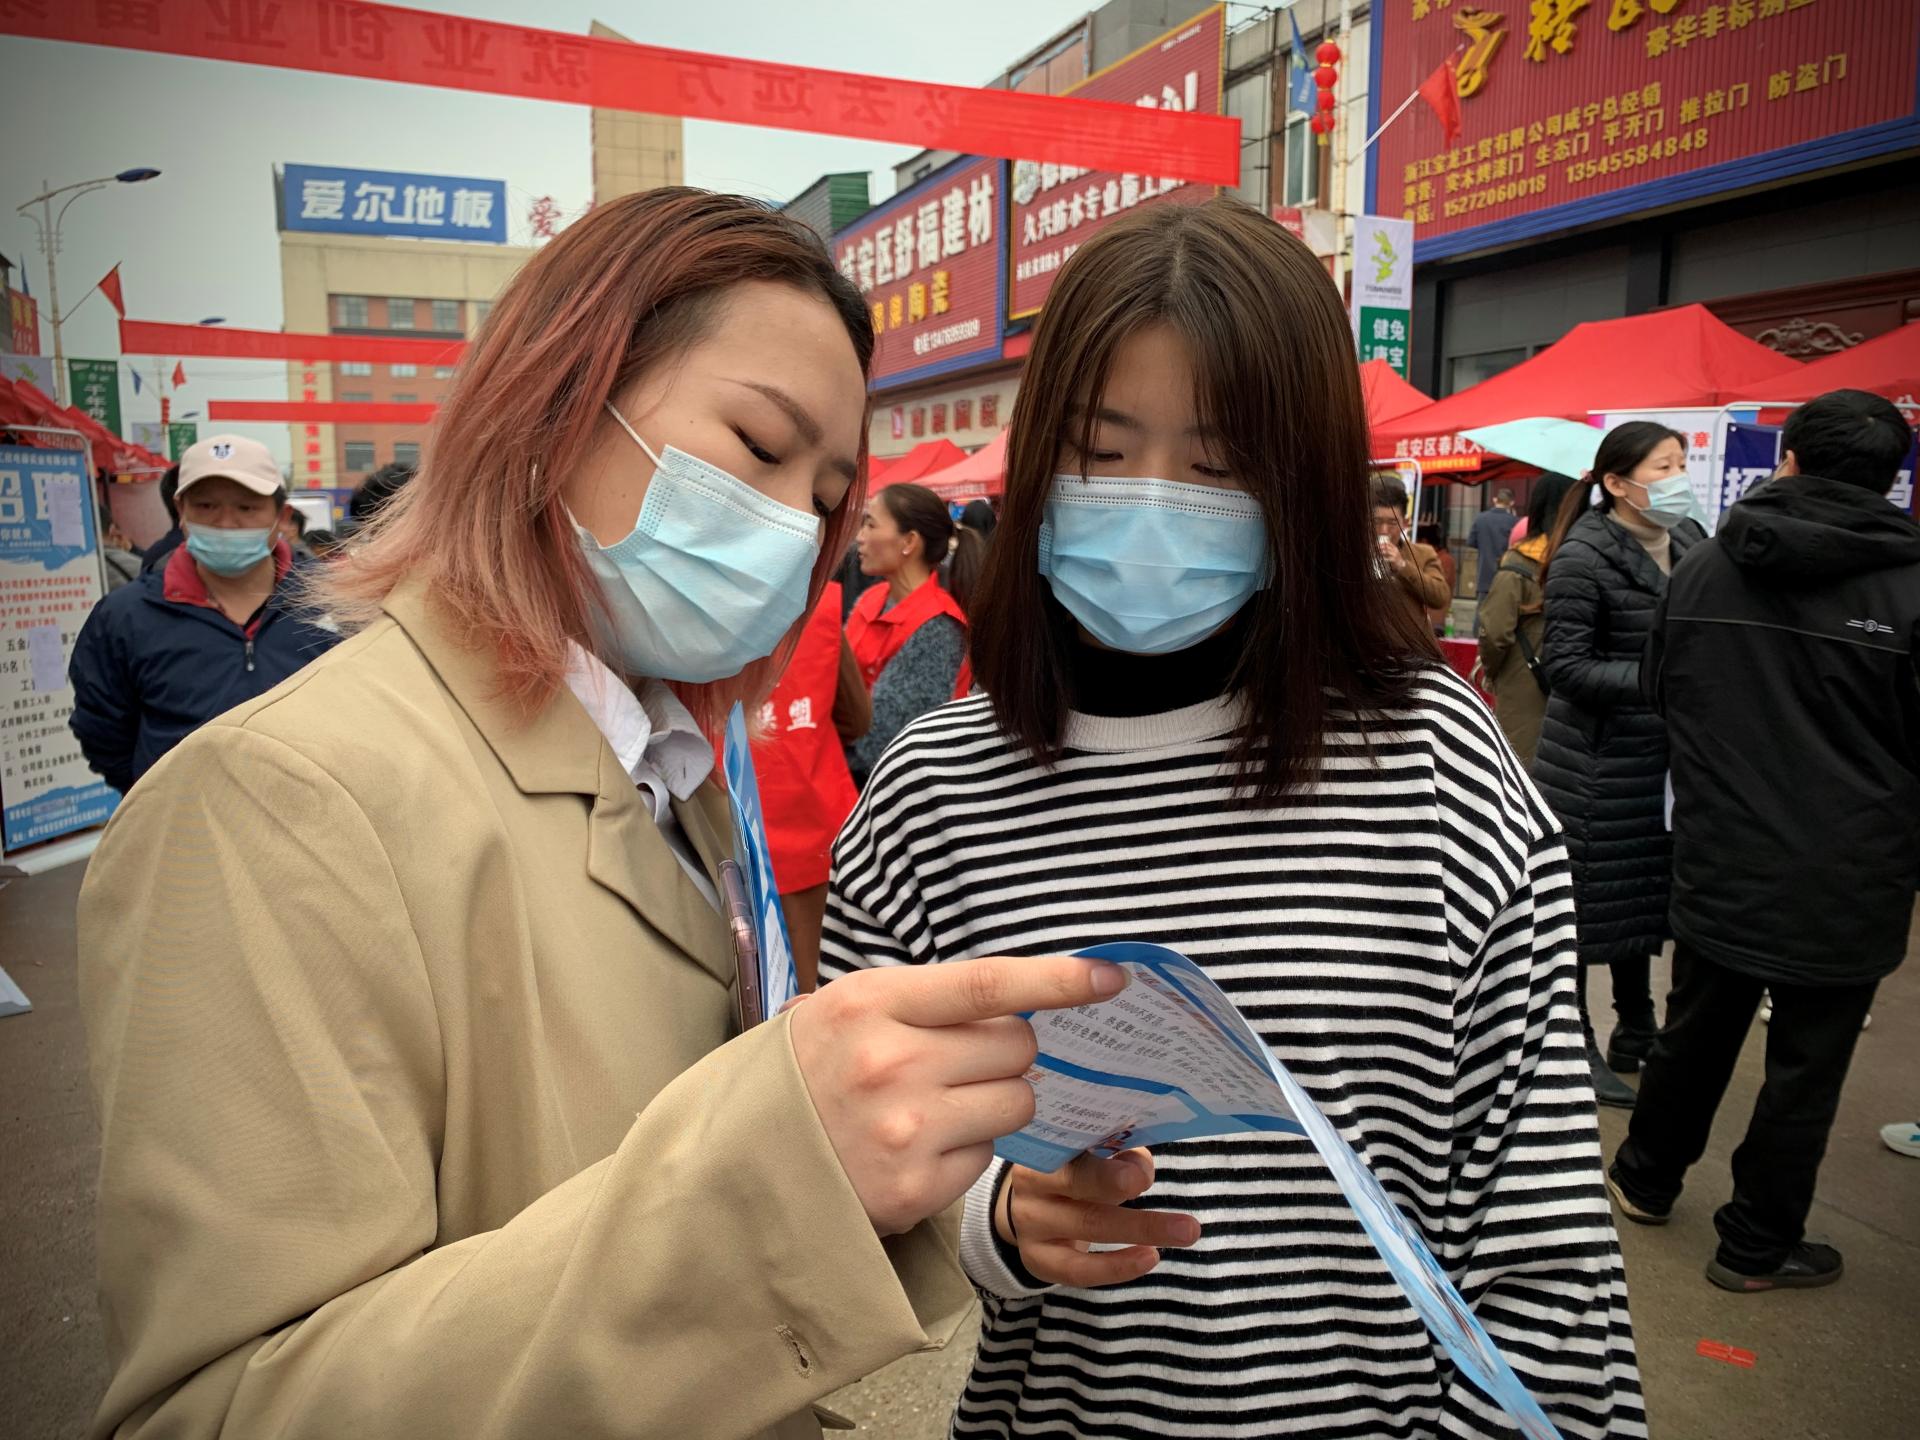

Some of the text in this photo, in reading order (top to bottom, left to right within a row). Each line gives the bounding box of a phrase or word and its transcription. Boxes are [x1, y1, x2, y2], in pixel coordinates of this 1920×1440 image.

[1646, 0, 1817, 58] 豪华非标别
[1535, 133, 1590, 168] 生态门
[1602, 108, 1665, 146] 平开门
[1679, 82, 1750, 125] 推拉门
[1767, 53, 1848, 101] 防盗门
[301, 179, 494, 232] 爱尔地板
[1443, 174, 1547, 219] 15272060018
[1566, 127, 1709, 184] 13545584848
